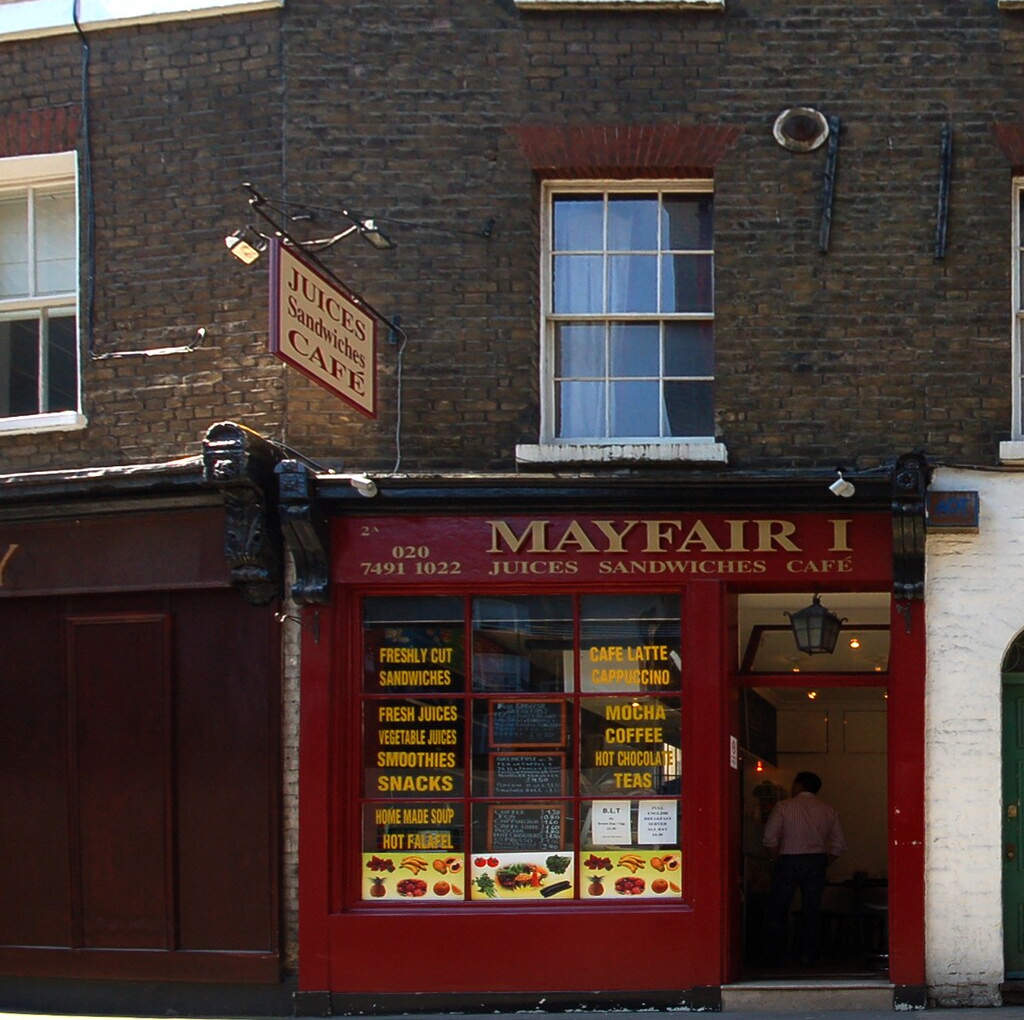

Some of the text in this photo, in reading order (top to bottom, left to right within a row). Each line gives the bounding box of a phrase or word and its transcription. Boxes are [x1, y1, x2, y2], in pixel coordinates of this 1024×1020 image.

[288, 267, 365, 341] JUICES
[288, 295, 365, 368] Sandwiches
[288, 329, 365, 396] CAFÉ
[486, 519, 853, 553] MAYFAIR I
[392, 546, 430, 559] 020
[360, 562, 461, 575] 7491 1022
[489, 556, 853, 575] JUICES SANDWICHES CAFÉ
[379, 648, 453, 664] FRESHLY CUT
[589, 645, 668, 661] CAFE LATTE
[379, 669, 451, 686] SANDWICHES
[591, 669, 670, 685] CAPPUCCINO
[379, 706, 457, 722] FRESH JUICES
[605, 705, 666, 721] MOCHA
[379, 729, 457, 745] VEGETABLE JUICES
[605, 727, 663, 743] COFFEE
[377, 751, 455, 768] SMOOTHIES
[595, 750, 674, 766] HOT CHOCOLATE
[378, 775, 453, 791] SNACKS
[613, 773, 652, 788] TEAS
[376, 808, 454, 825] HOME MADE SOUP
[383, 833, 454, 849] HOT FALAFEL
